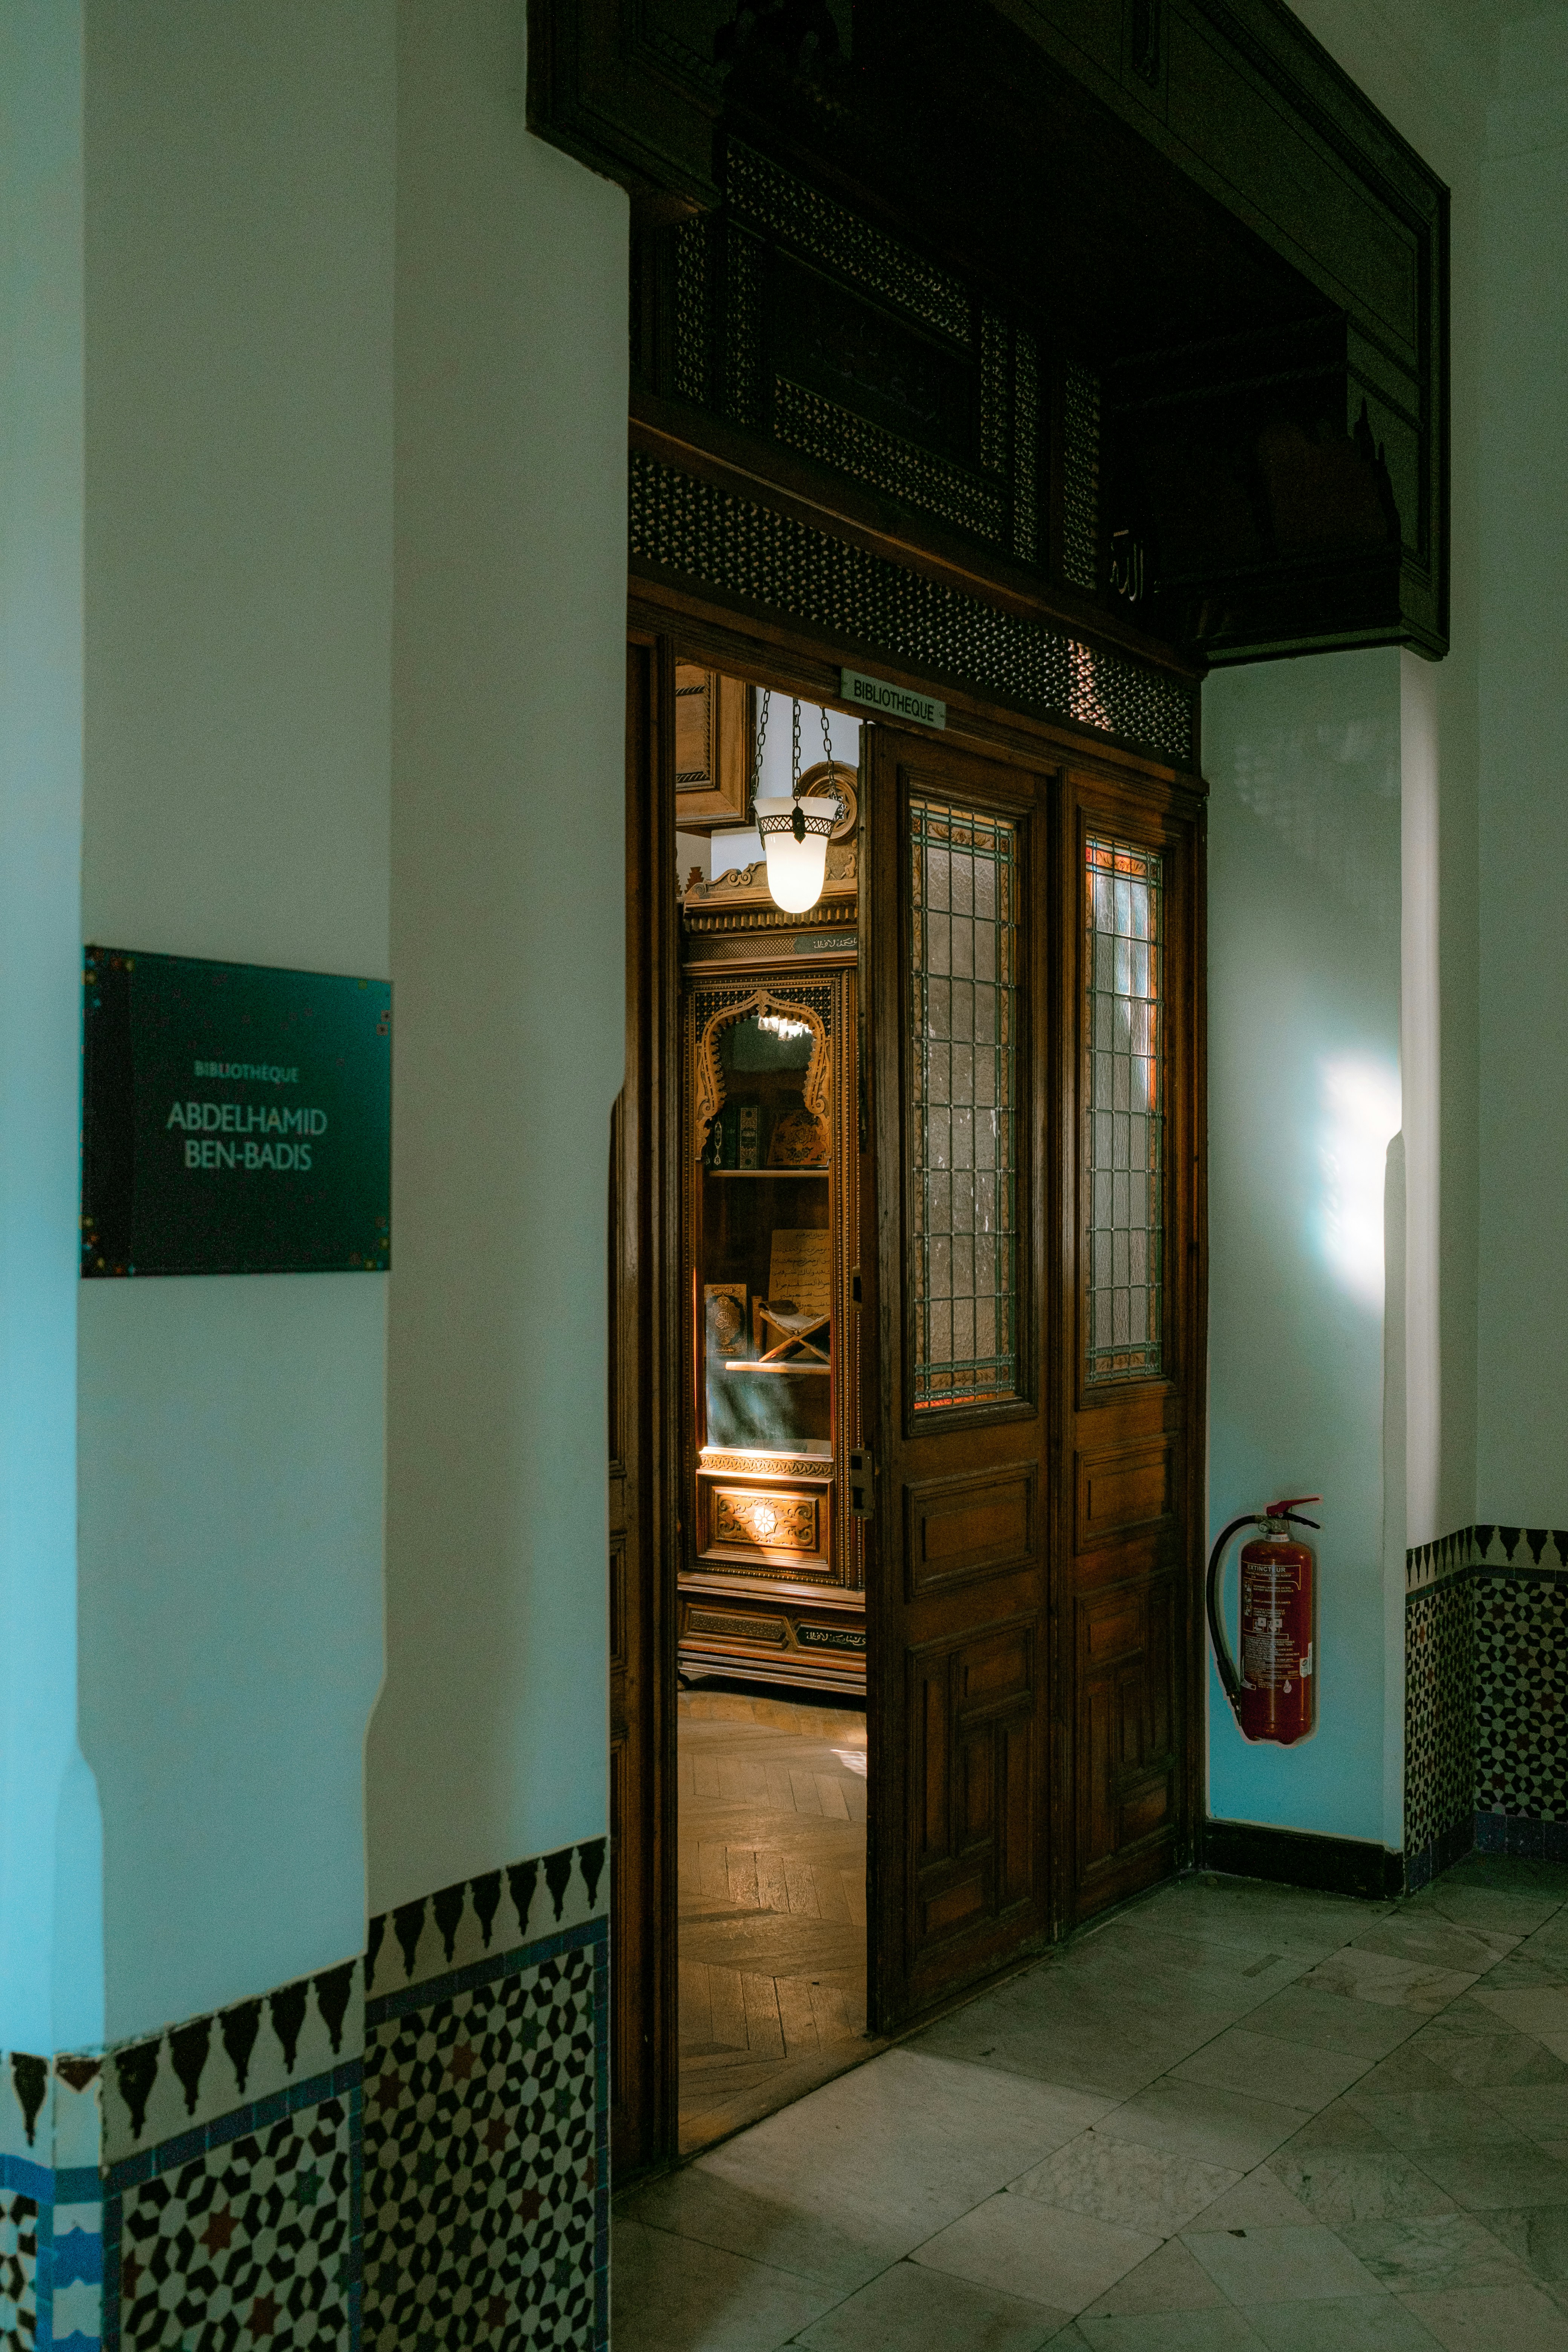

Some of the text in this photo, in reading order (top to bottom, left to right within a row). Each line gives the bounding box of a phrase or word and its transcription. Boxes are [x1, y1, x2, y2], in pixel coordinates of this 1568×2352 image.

[854, 679, 934, 722] BIBLIOTHEQUE
[166, 1101, 327, 1135] ABDELHAMID
[185, 1140, 312, 1171] BEN-BADIS
[1247, 1564, 1286, 1573] EXTINCTEUR
